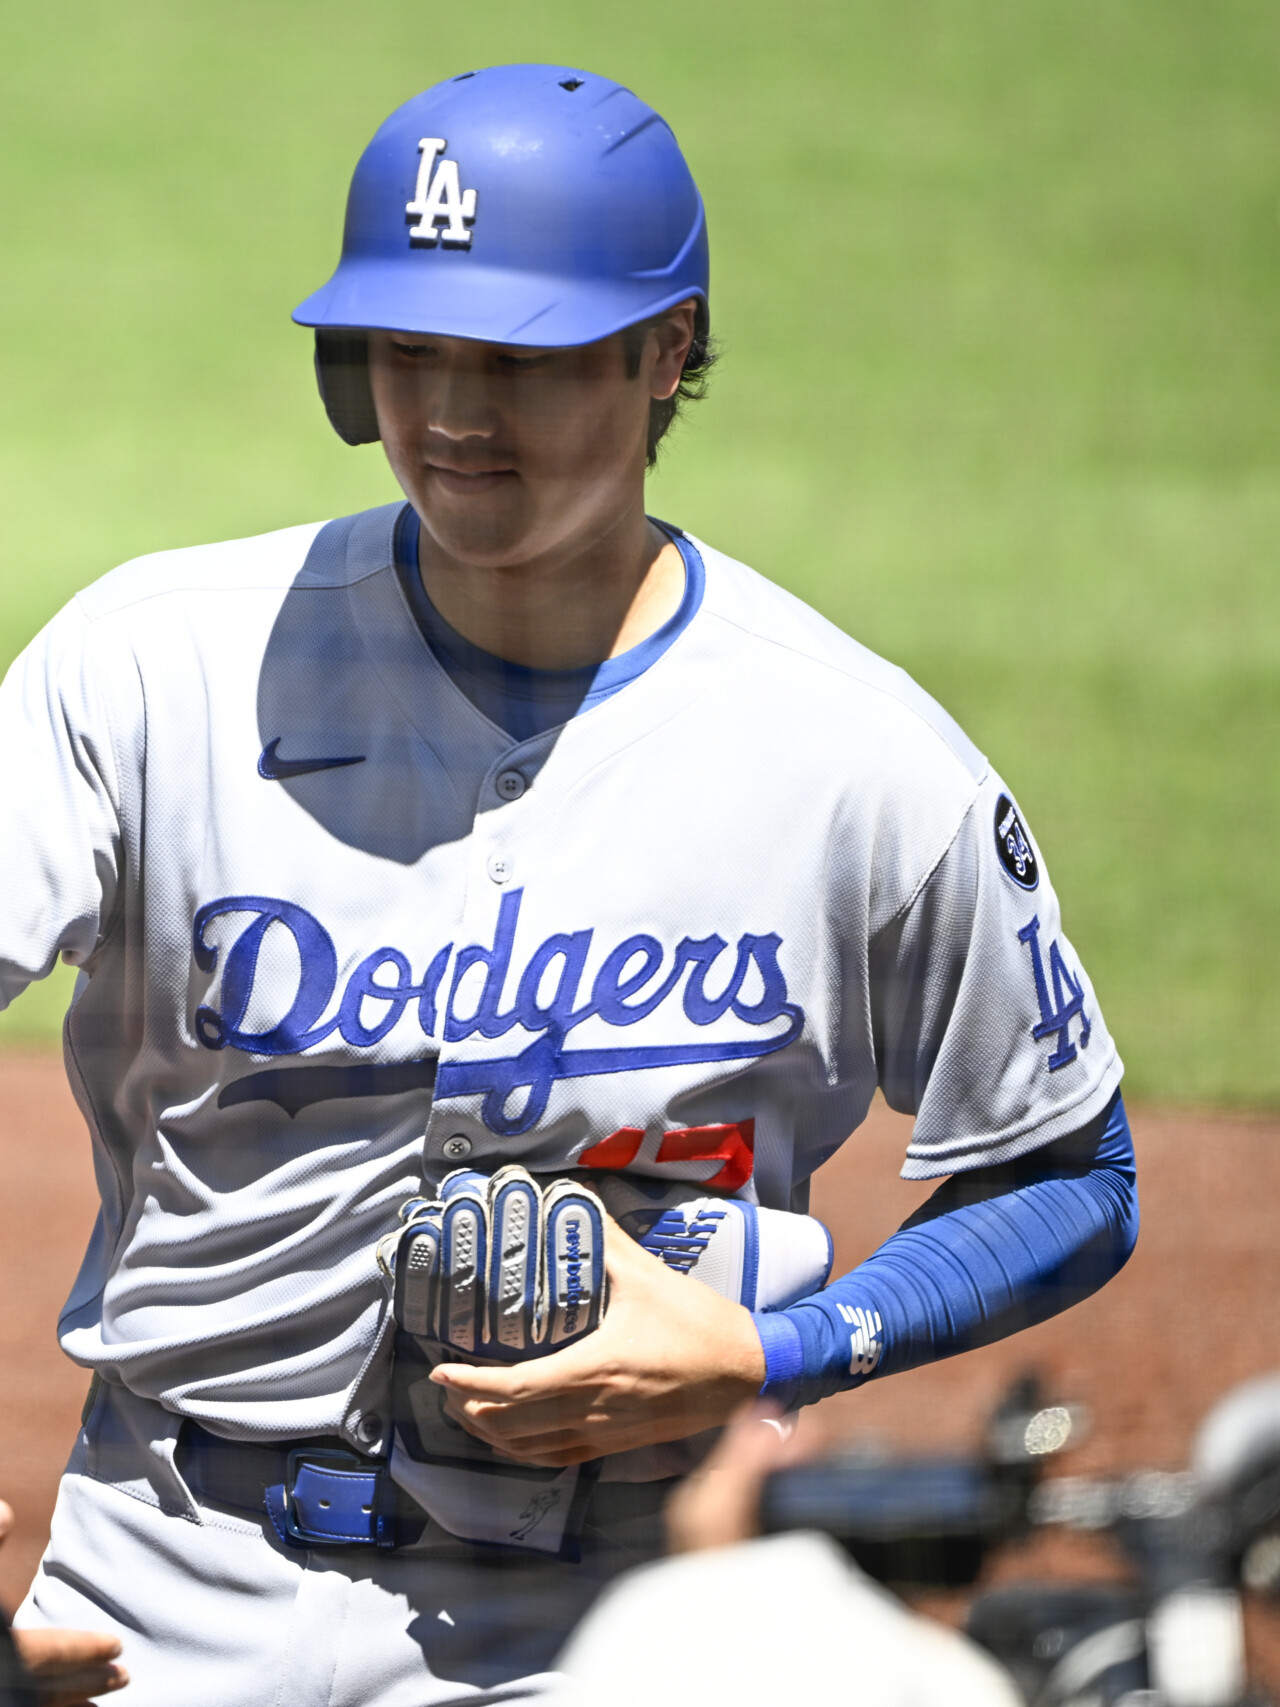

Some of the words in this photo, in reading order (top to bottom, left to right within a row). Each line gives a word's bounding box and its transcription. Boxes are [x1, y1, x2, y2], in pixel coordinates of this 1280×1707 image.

[405, 137, 478, 244] LA
[193, 886, 804, 1136] Dodgers
[1017, 913, 1091, 1073] LA
[565, 1220, 580, 1259] new
[563, 1261, 584, 1334] balance
